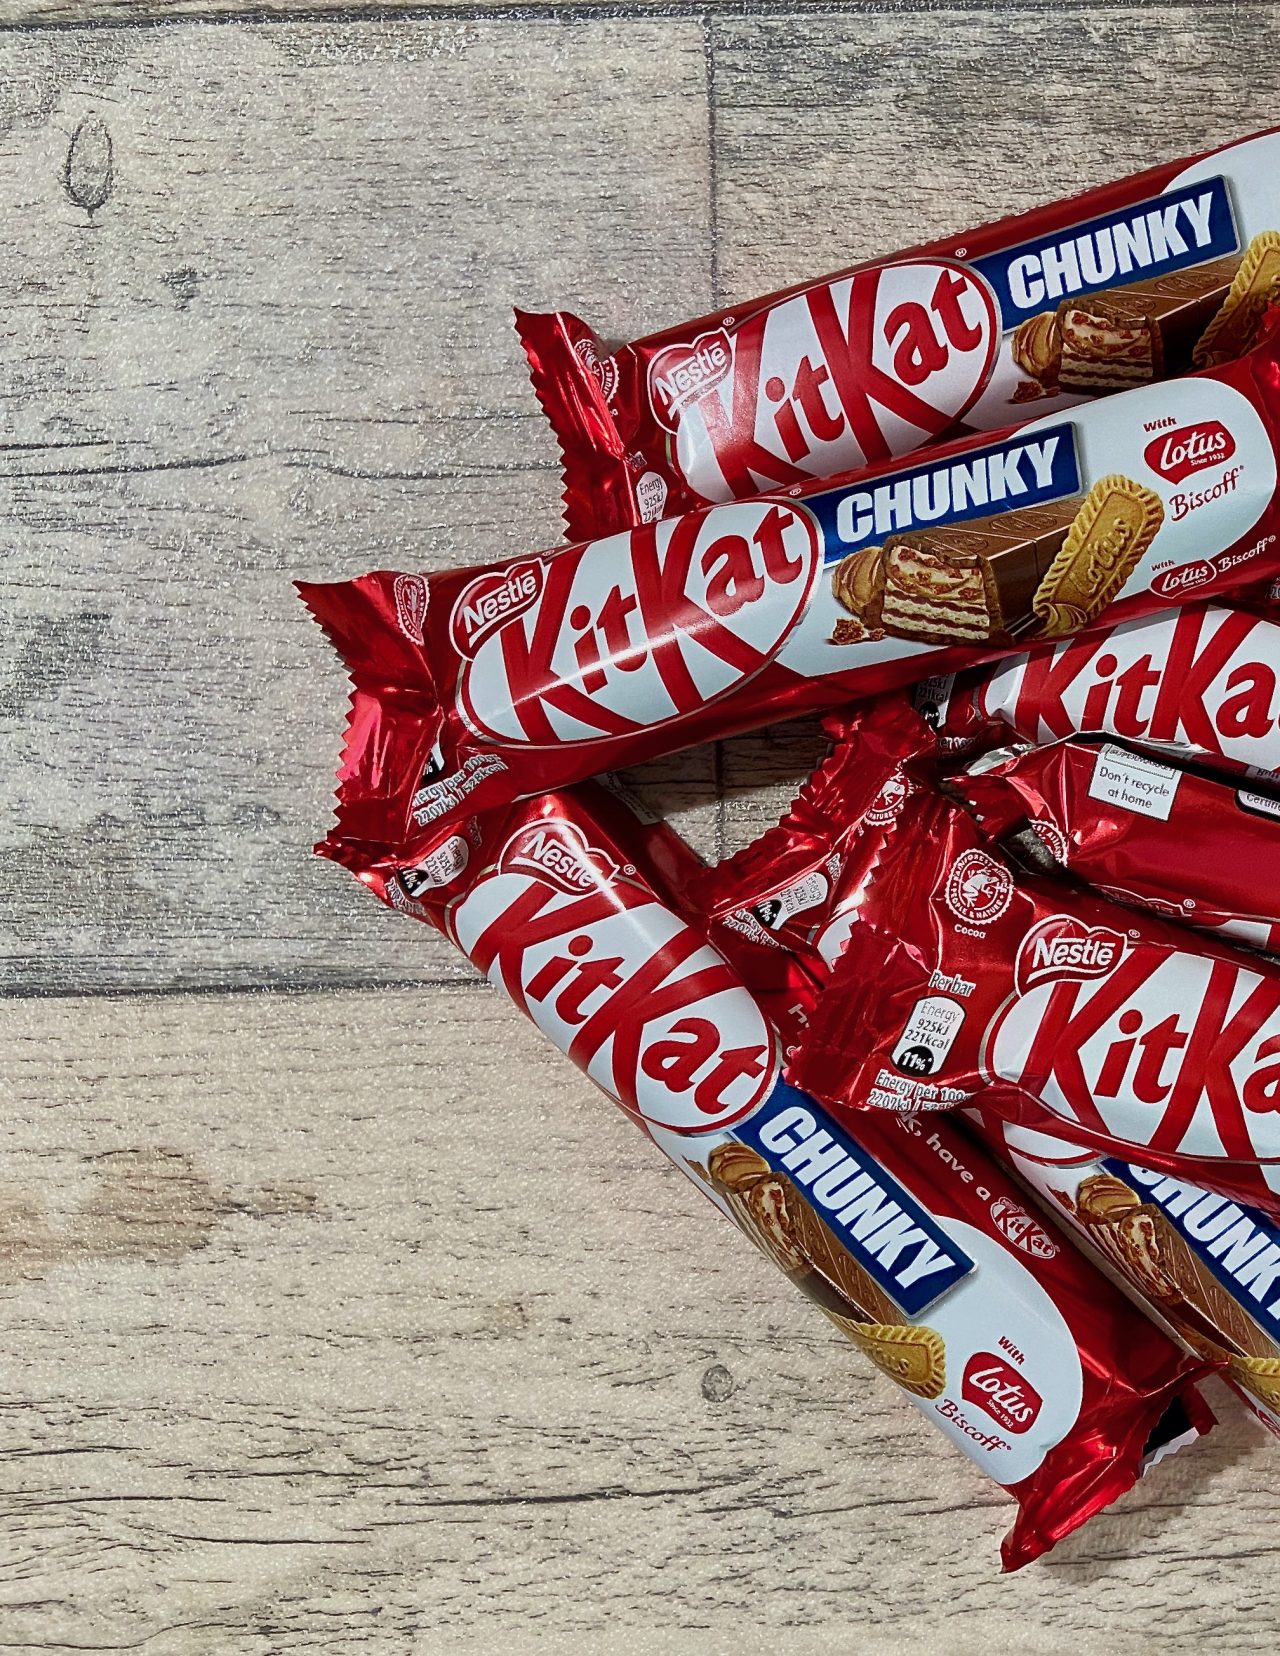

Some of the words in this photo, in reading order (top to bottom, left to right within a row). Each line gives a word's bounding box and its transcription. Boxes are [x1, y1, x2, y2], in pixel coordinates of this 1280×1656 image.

[1007, 191, 1215, 309] CHUNKY
[655, 341, 727, 403] Nestlé
[699, 268, 984, 496] KitKat
[1143, 417, 1177, 432] With
[1160, 431, 1226, 471] Lotus
[836, 436, 1059, 544] CHUNKY
[1169, 467, 1239, 521] Biscoff
[1161, 566, 1208, 592] Lotus
[1218, 536, 1270, 573] Biscoff
[462, 572, 536, 634] Nestlé
[500, 506, 803, 742] KitKat
[1100, 766, 1130, 783] Don't
[1131, 780, 1170, 797] recycle
[1108, 789, 1119, 799] at
[1121, 789, 1153, 809] home
[954, 923, 986, 939] Cocoa
[1031, 940, 1113, 973] Nestlé
[469, 881, 767, 1114] KitKat
[930, 971, 951, 989] Per
[951, 973, 976, 996] bar
[916, 1018, 949, 1036] 925kJ
[921, 1001, 960, 1023] Energy
[905, 1030, 950, 1050] 221kcal
[876, 1071, 913, 1096] Energy
[913, 1083, 938, 1101] per
[758, 1105, 956, 1289] CHUNKY
[927, 1134, 975, 1182] have
[976, 1186, 991, 1200] a
[995, 1202, 1055, 1258] KitKat
[998, 1336, 1025, 1365] With
[969, 1367, 1033, 1422] Lotus
[935, 1399, 1006, 1451] Biscoff
